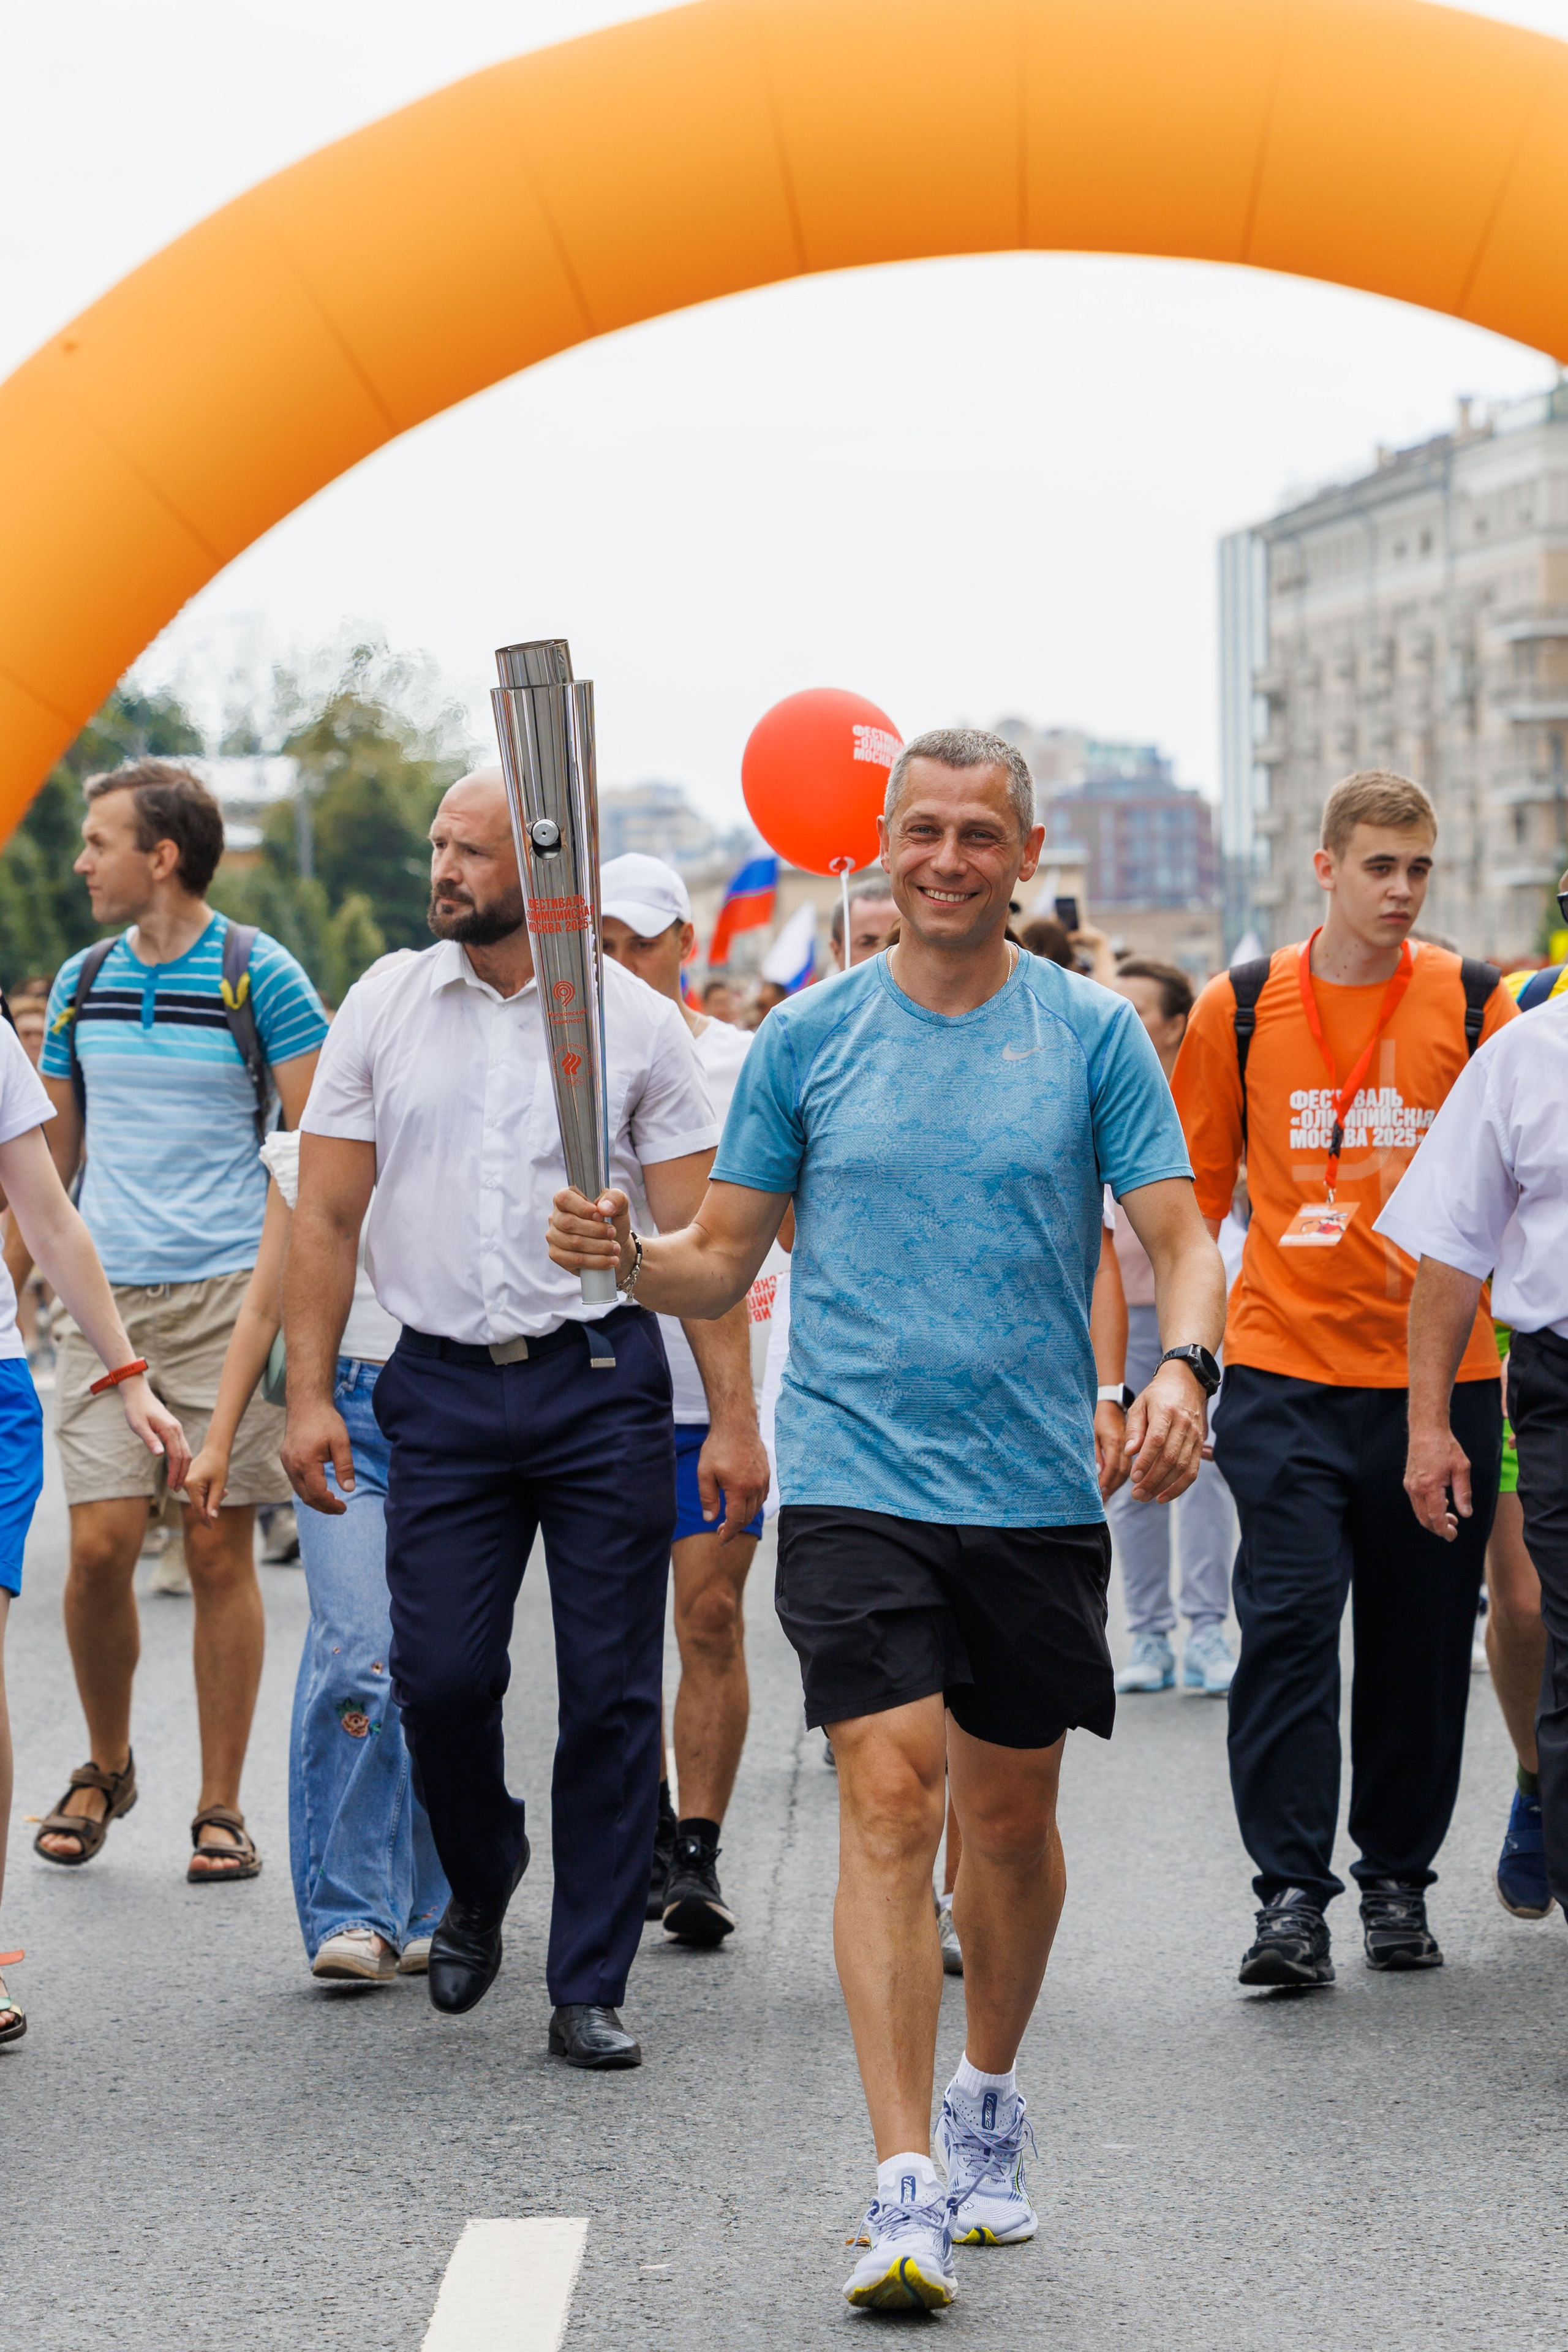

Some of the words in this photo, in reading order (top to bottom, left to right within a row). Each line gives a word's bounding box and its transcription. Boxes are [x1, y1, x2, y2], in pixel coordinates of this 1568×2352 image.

[528, 894, 585, 910] ФЕСТИВАЛЬ
[529, 921, 562, 933] МОСКВА
[565, 919, 593, 932] 2025»
[548, 1008, 587, 1017] Московский
[1290, 1087, 1404, 1110] ФЕСВАЛЬ
[1290, 1128, 1368, 1149] МОСВА
